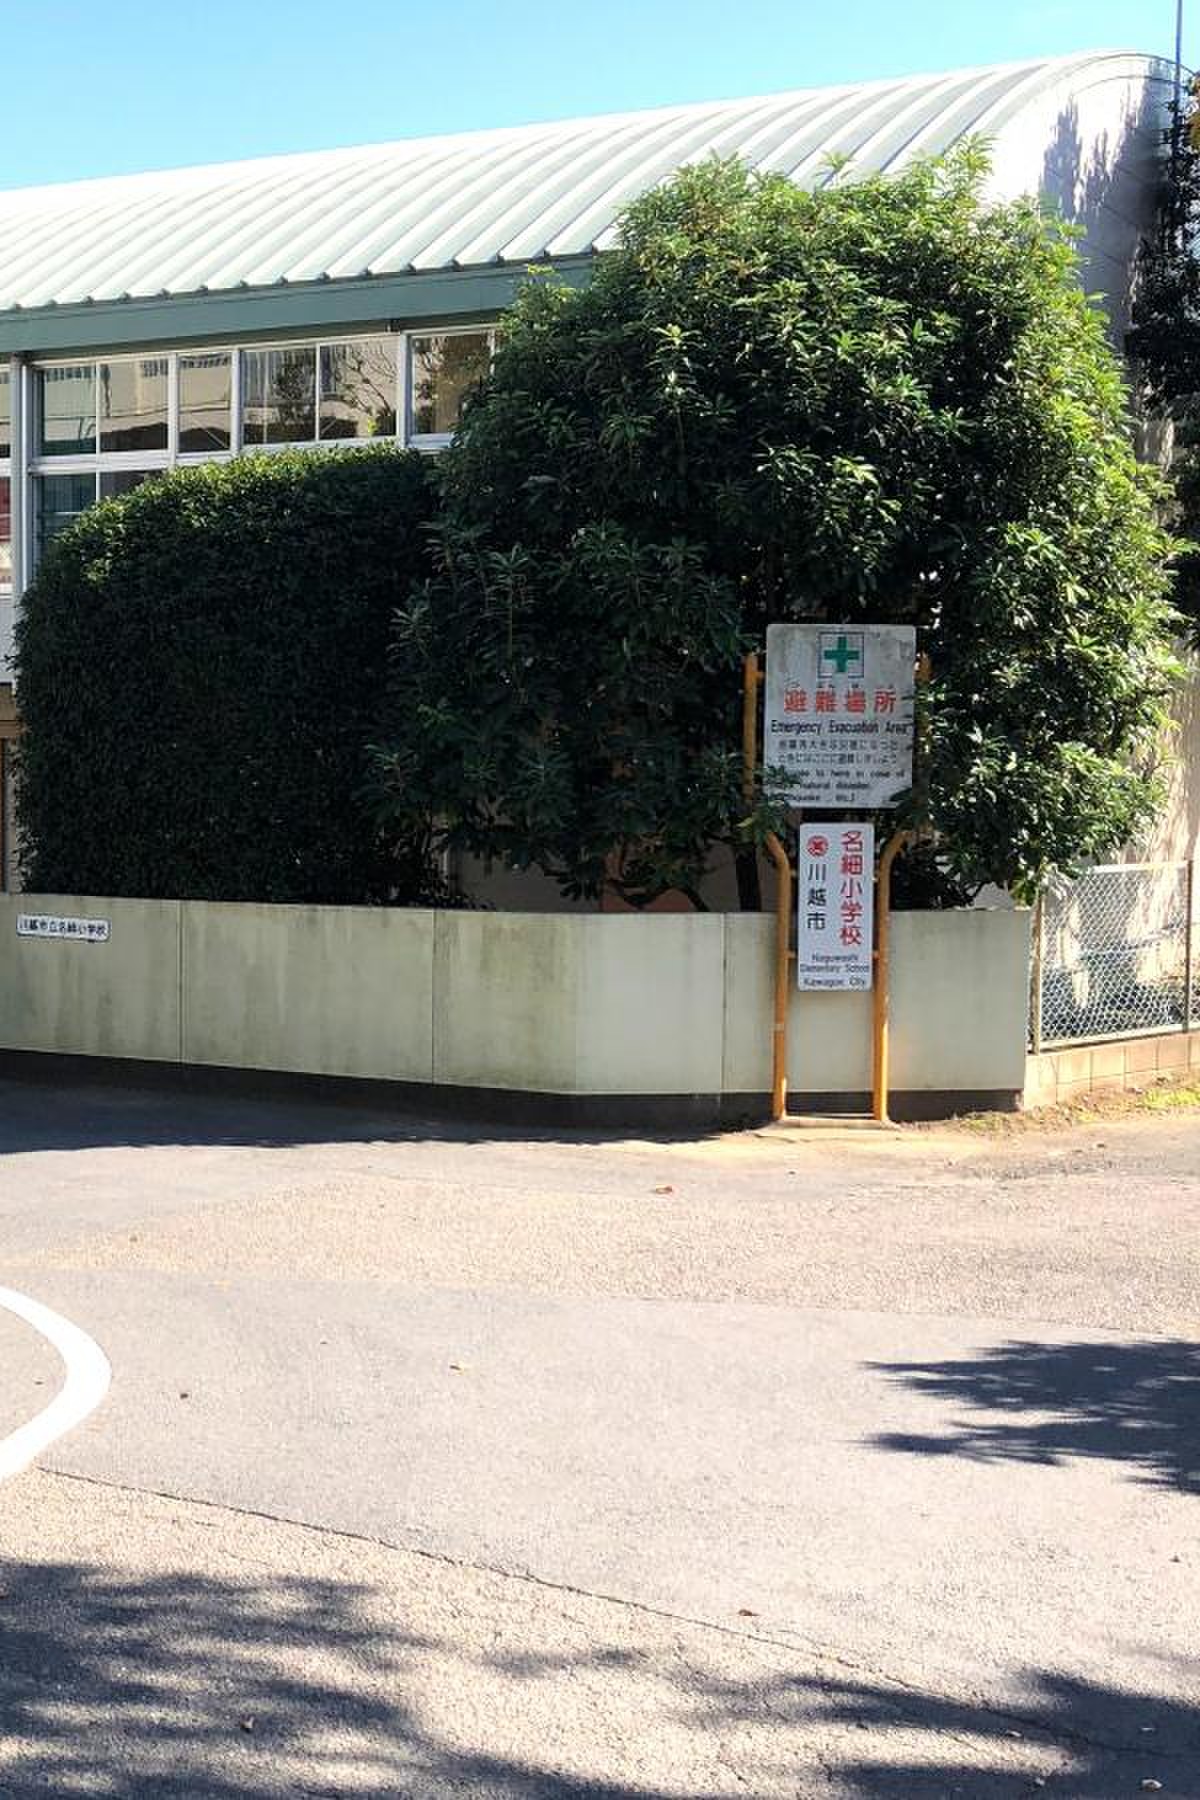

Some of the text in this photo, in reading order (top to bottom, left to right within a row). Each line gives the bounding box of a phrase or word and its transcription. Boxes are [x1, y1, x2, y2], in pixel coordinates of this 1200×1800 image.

[783, 687, 897, 714] 避難場所
[771, 719, 821, 734] Emergency
[828, 719, 879, 734] Evacuation
[806, 863, 827, 930] 川越市
[840, 831, 863, 946] 名細小学校
